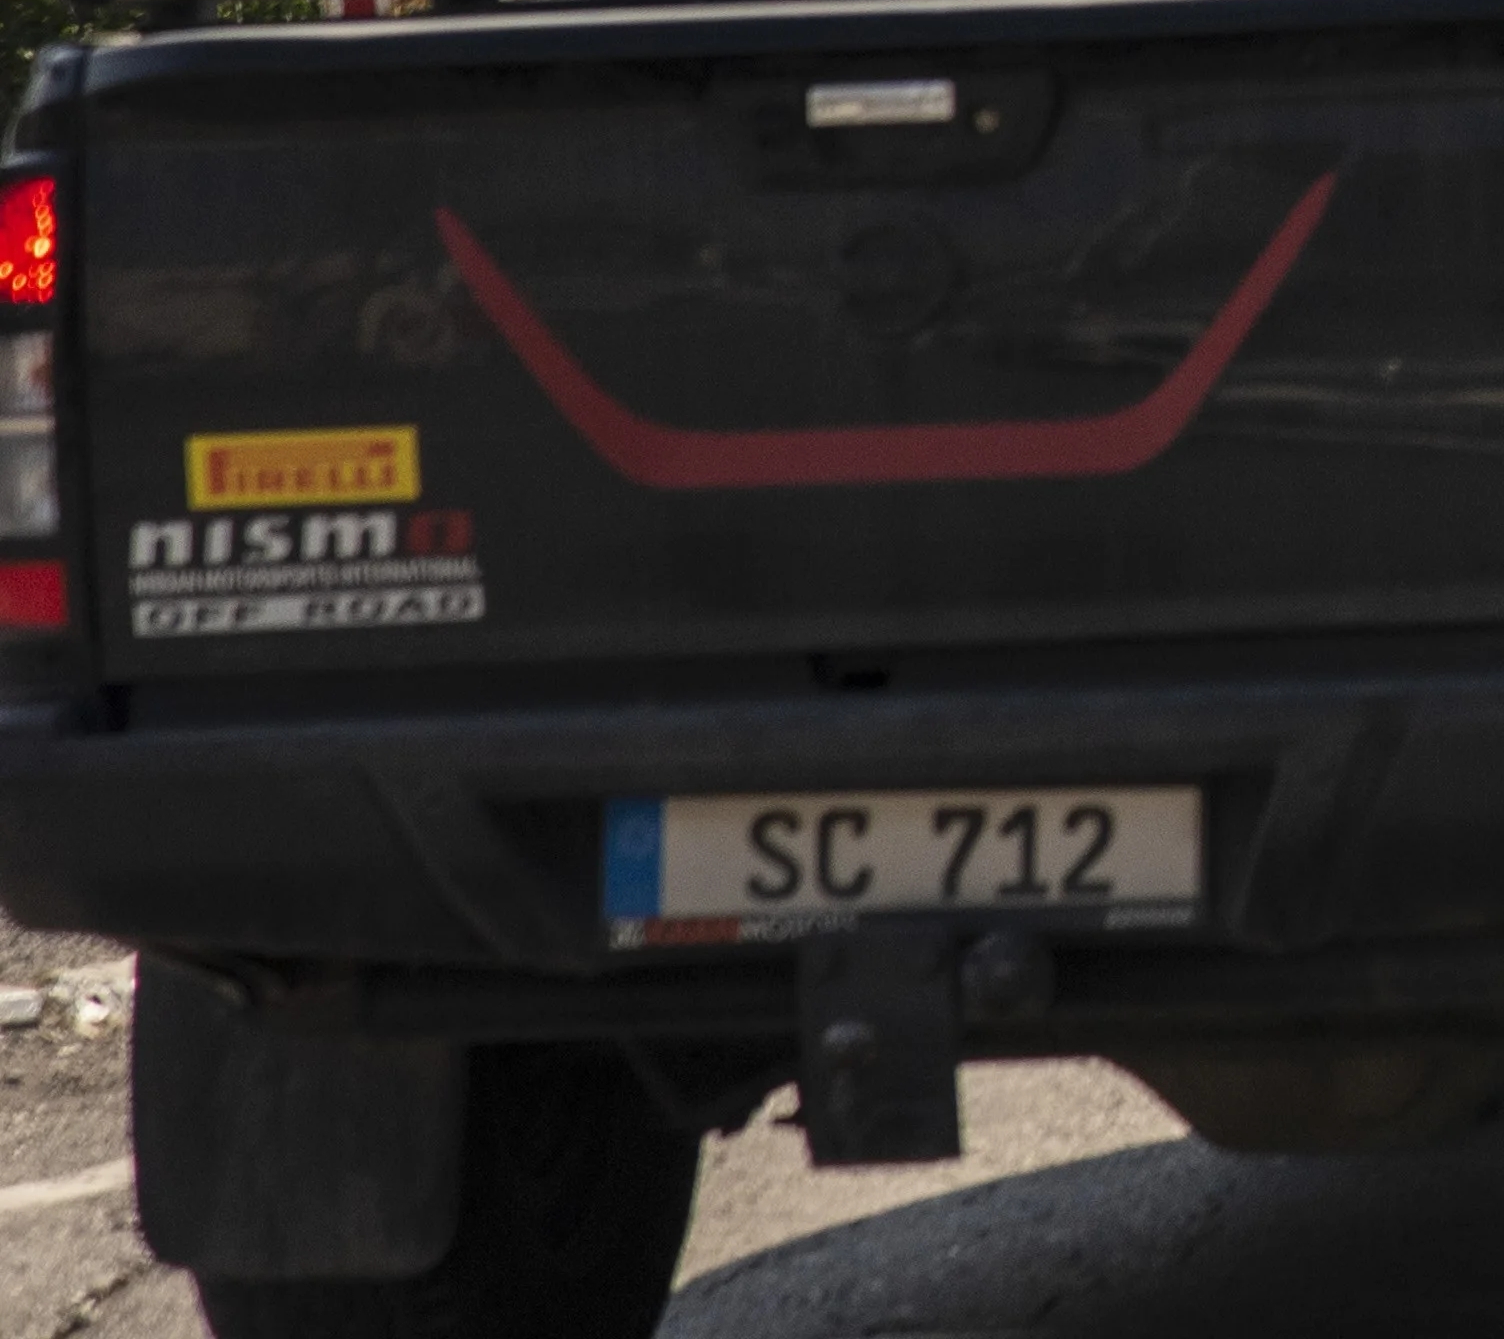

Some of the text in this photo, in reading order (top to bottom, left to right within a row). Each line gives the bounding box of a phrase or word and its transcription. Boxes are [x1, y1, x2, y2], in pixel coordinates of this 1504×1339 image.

[207, 440, 397, 495] PIRELLI
[745, 802, 1116, 902] SC 712
